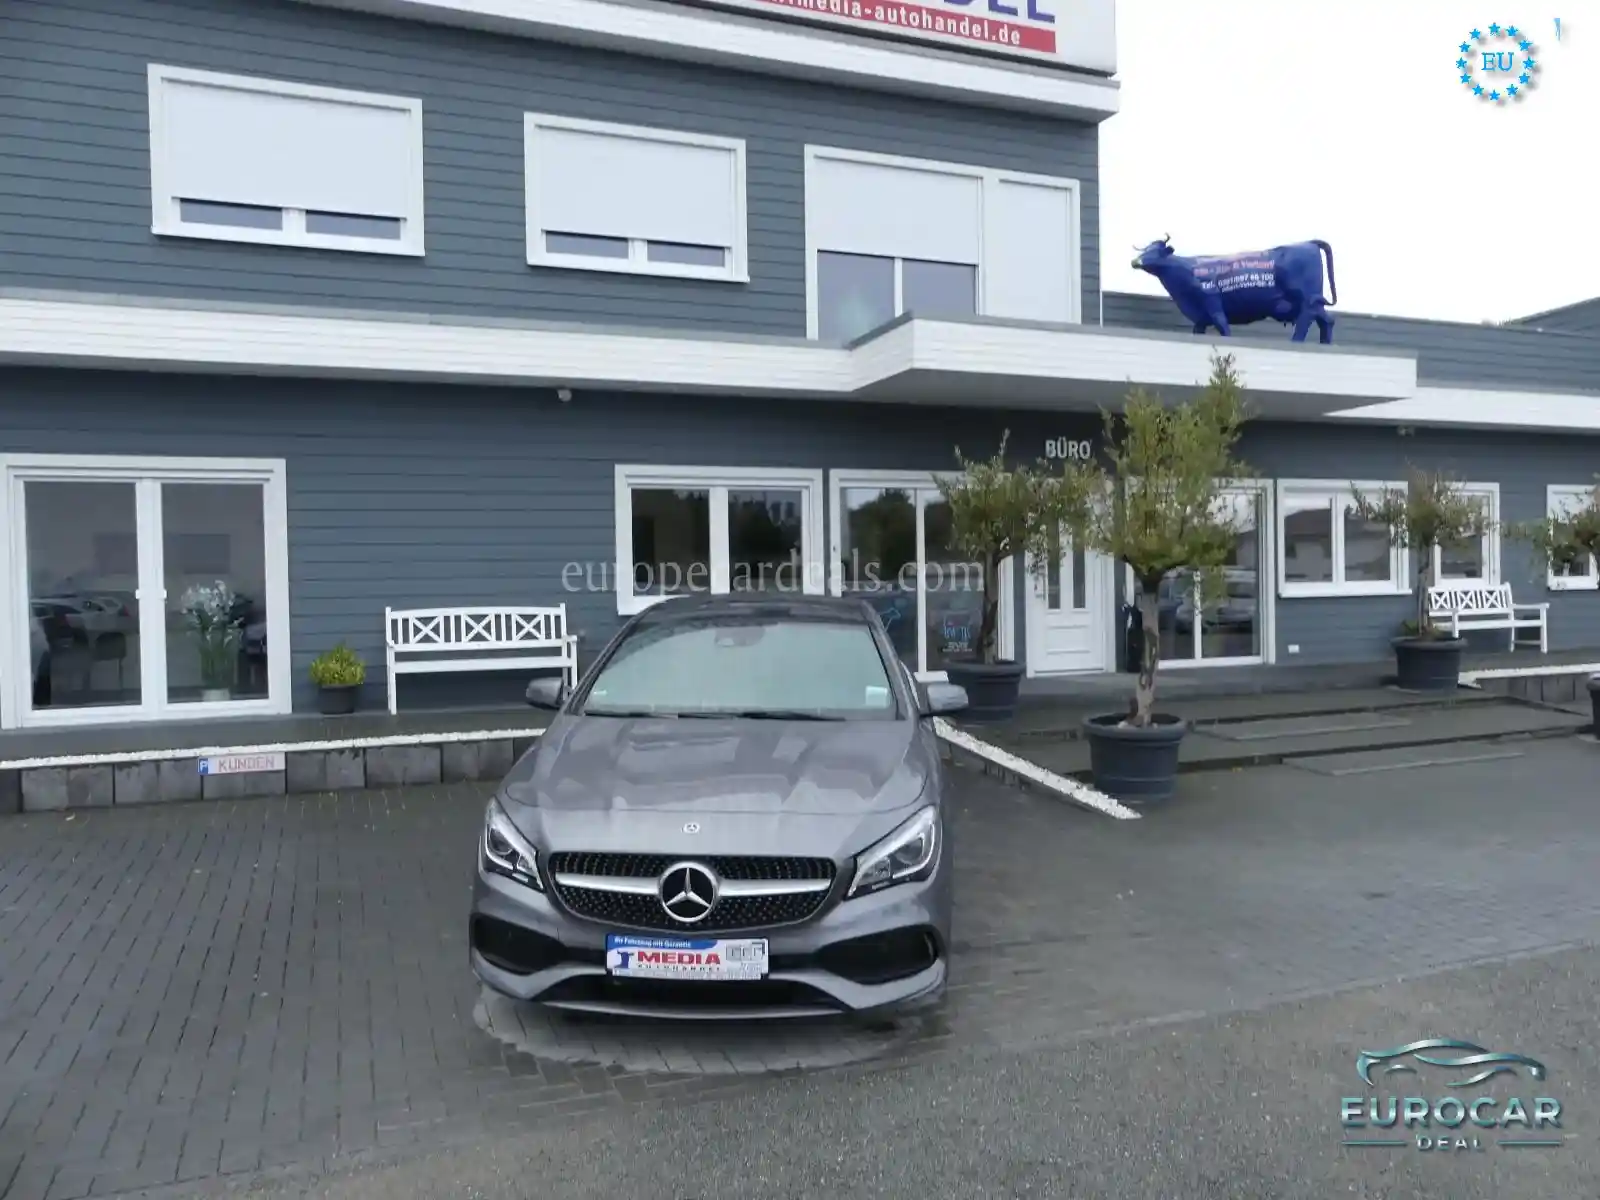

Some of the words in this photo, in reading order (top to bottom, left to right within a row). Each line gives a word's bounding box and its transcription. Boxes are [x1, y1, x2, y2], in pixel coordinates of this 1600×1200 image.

[1045, 436, 1091, 460] BÜRO
[218, 756, 275, 772] KUNDEN
[637, 951, 721, 965] MEDIA
